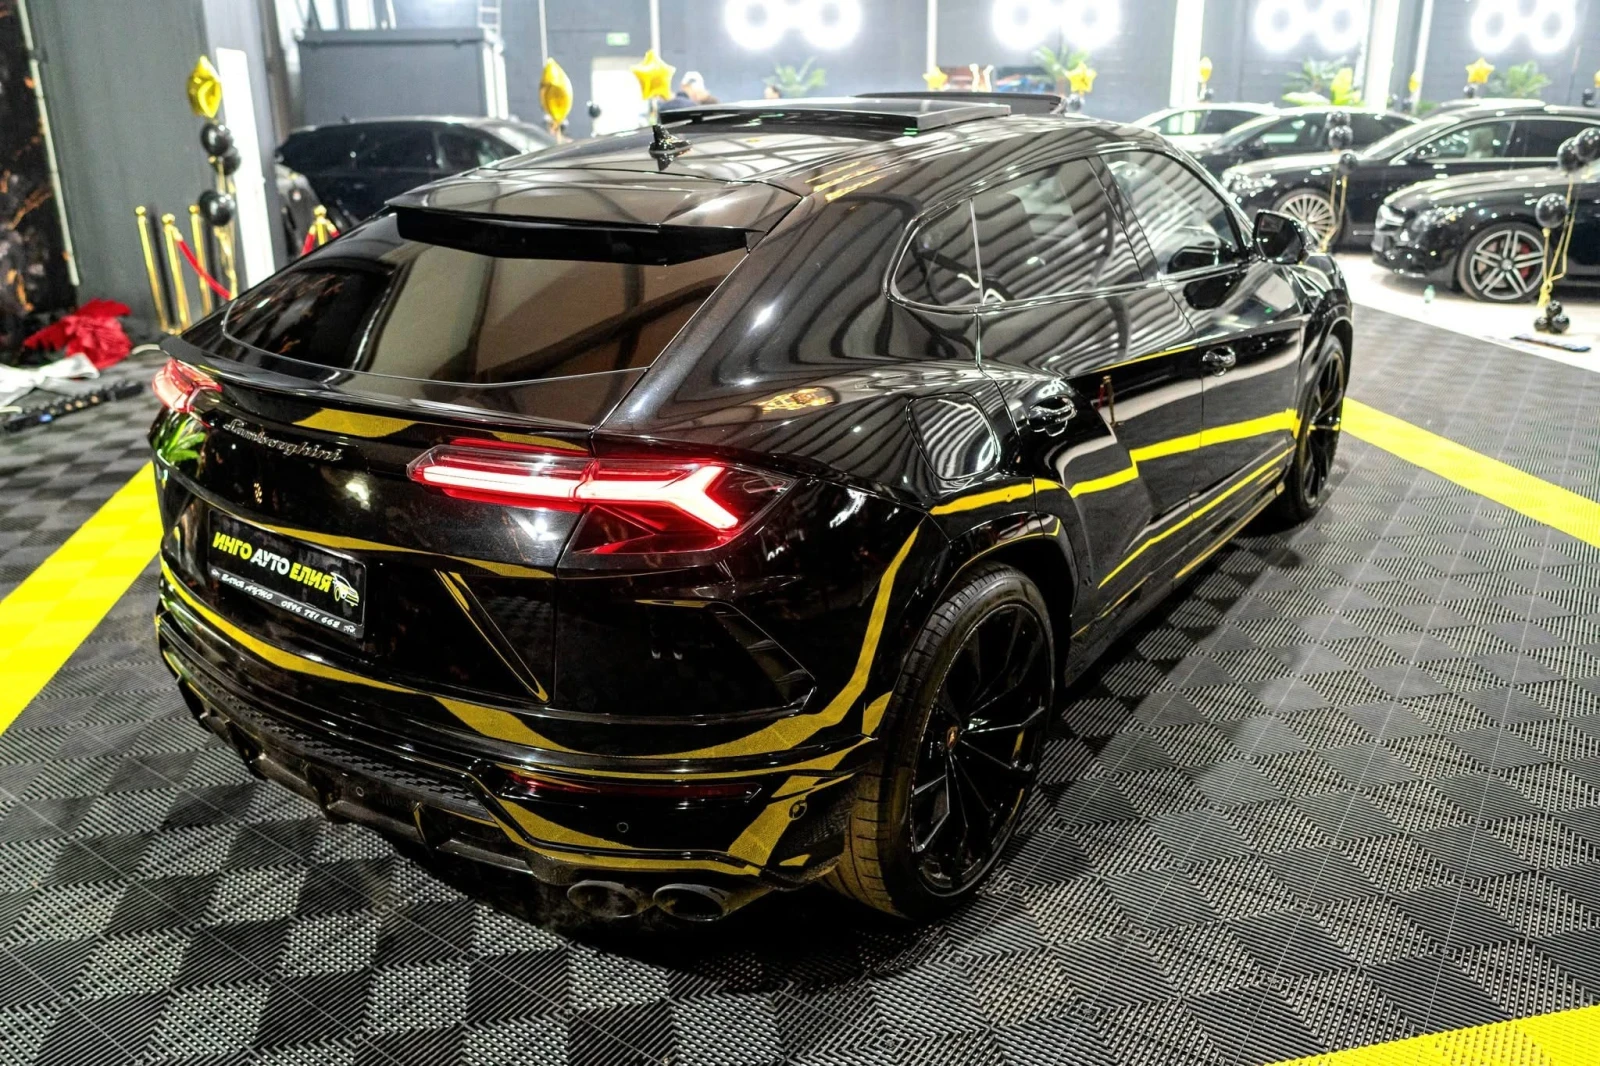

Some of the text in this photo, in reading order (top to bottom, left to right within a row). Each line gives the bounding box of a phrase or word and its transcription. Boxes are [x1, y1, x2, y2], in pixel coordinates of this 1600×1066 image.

[222, 418, 343, 461] Lamborghini
[212, 531, 333, 592] ИНГО АУТО ЕЛИЯ
